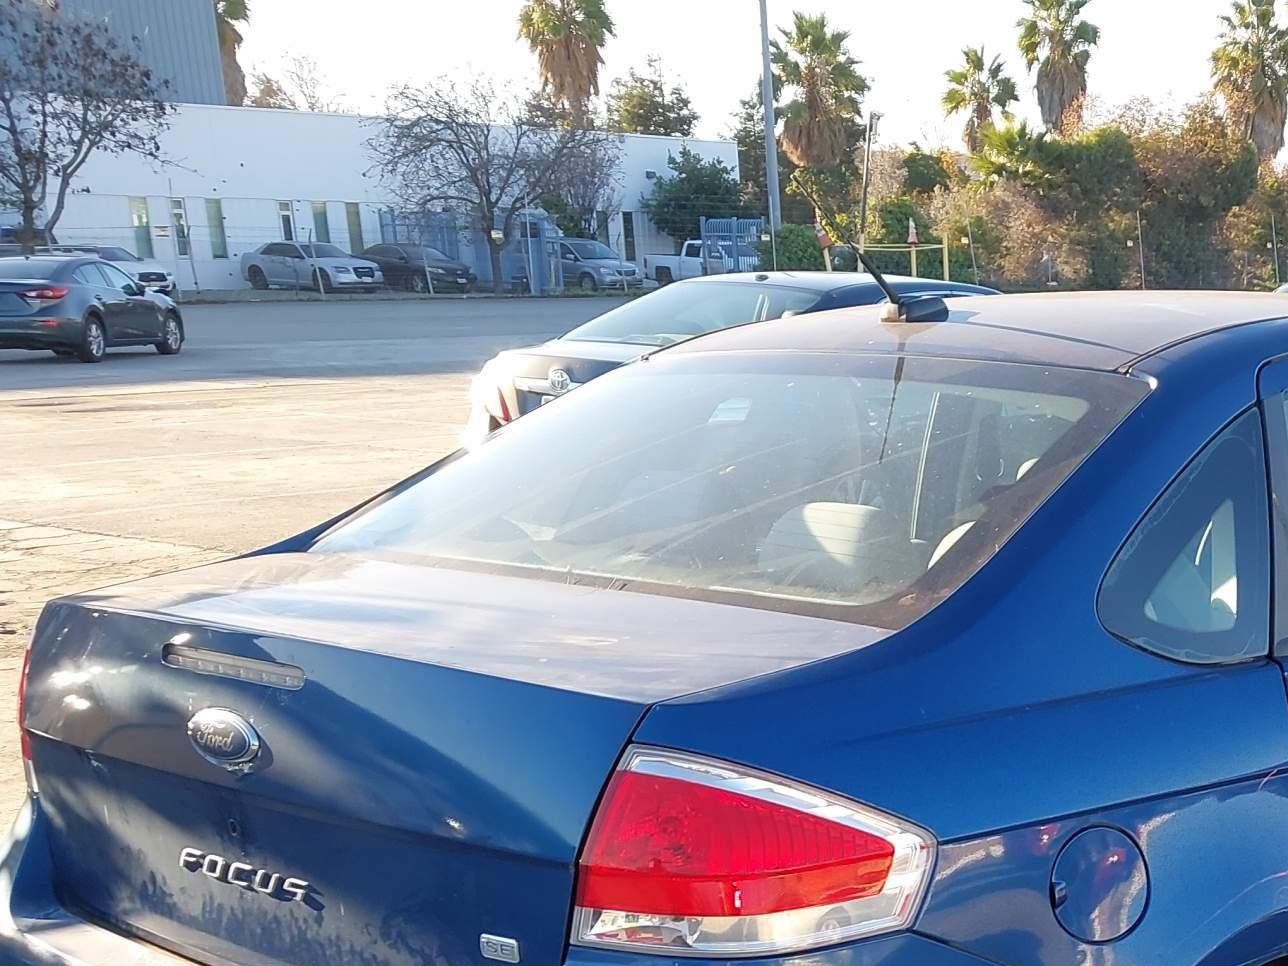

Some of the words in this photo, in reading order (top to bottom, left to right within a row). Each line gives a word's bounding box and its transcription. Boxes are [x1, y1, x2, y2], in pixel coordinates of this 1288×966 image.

[196, 721, 235, 752] Ford
[179, 847, 309, 901] FOCUS
[484, 940, 513, 958] SE
